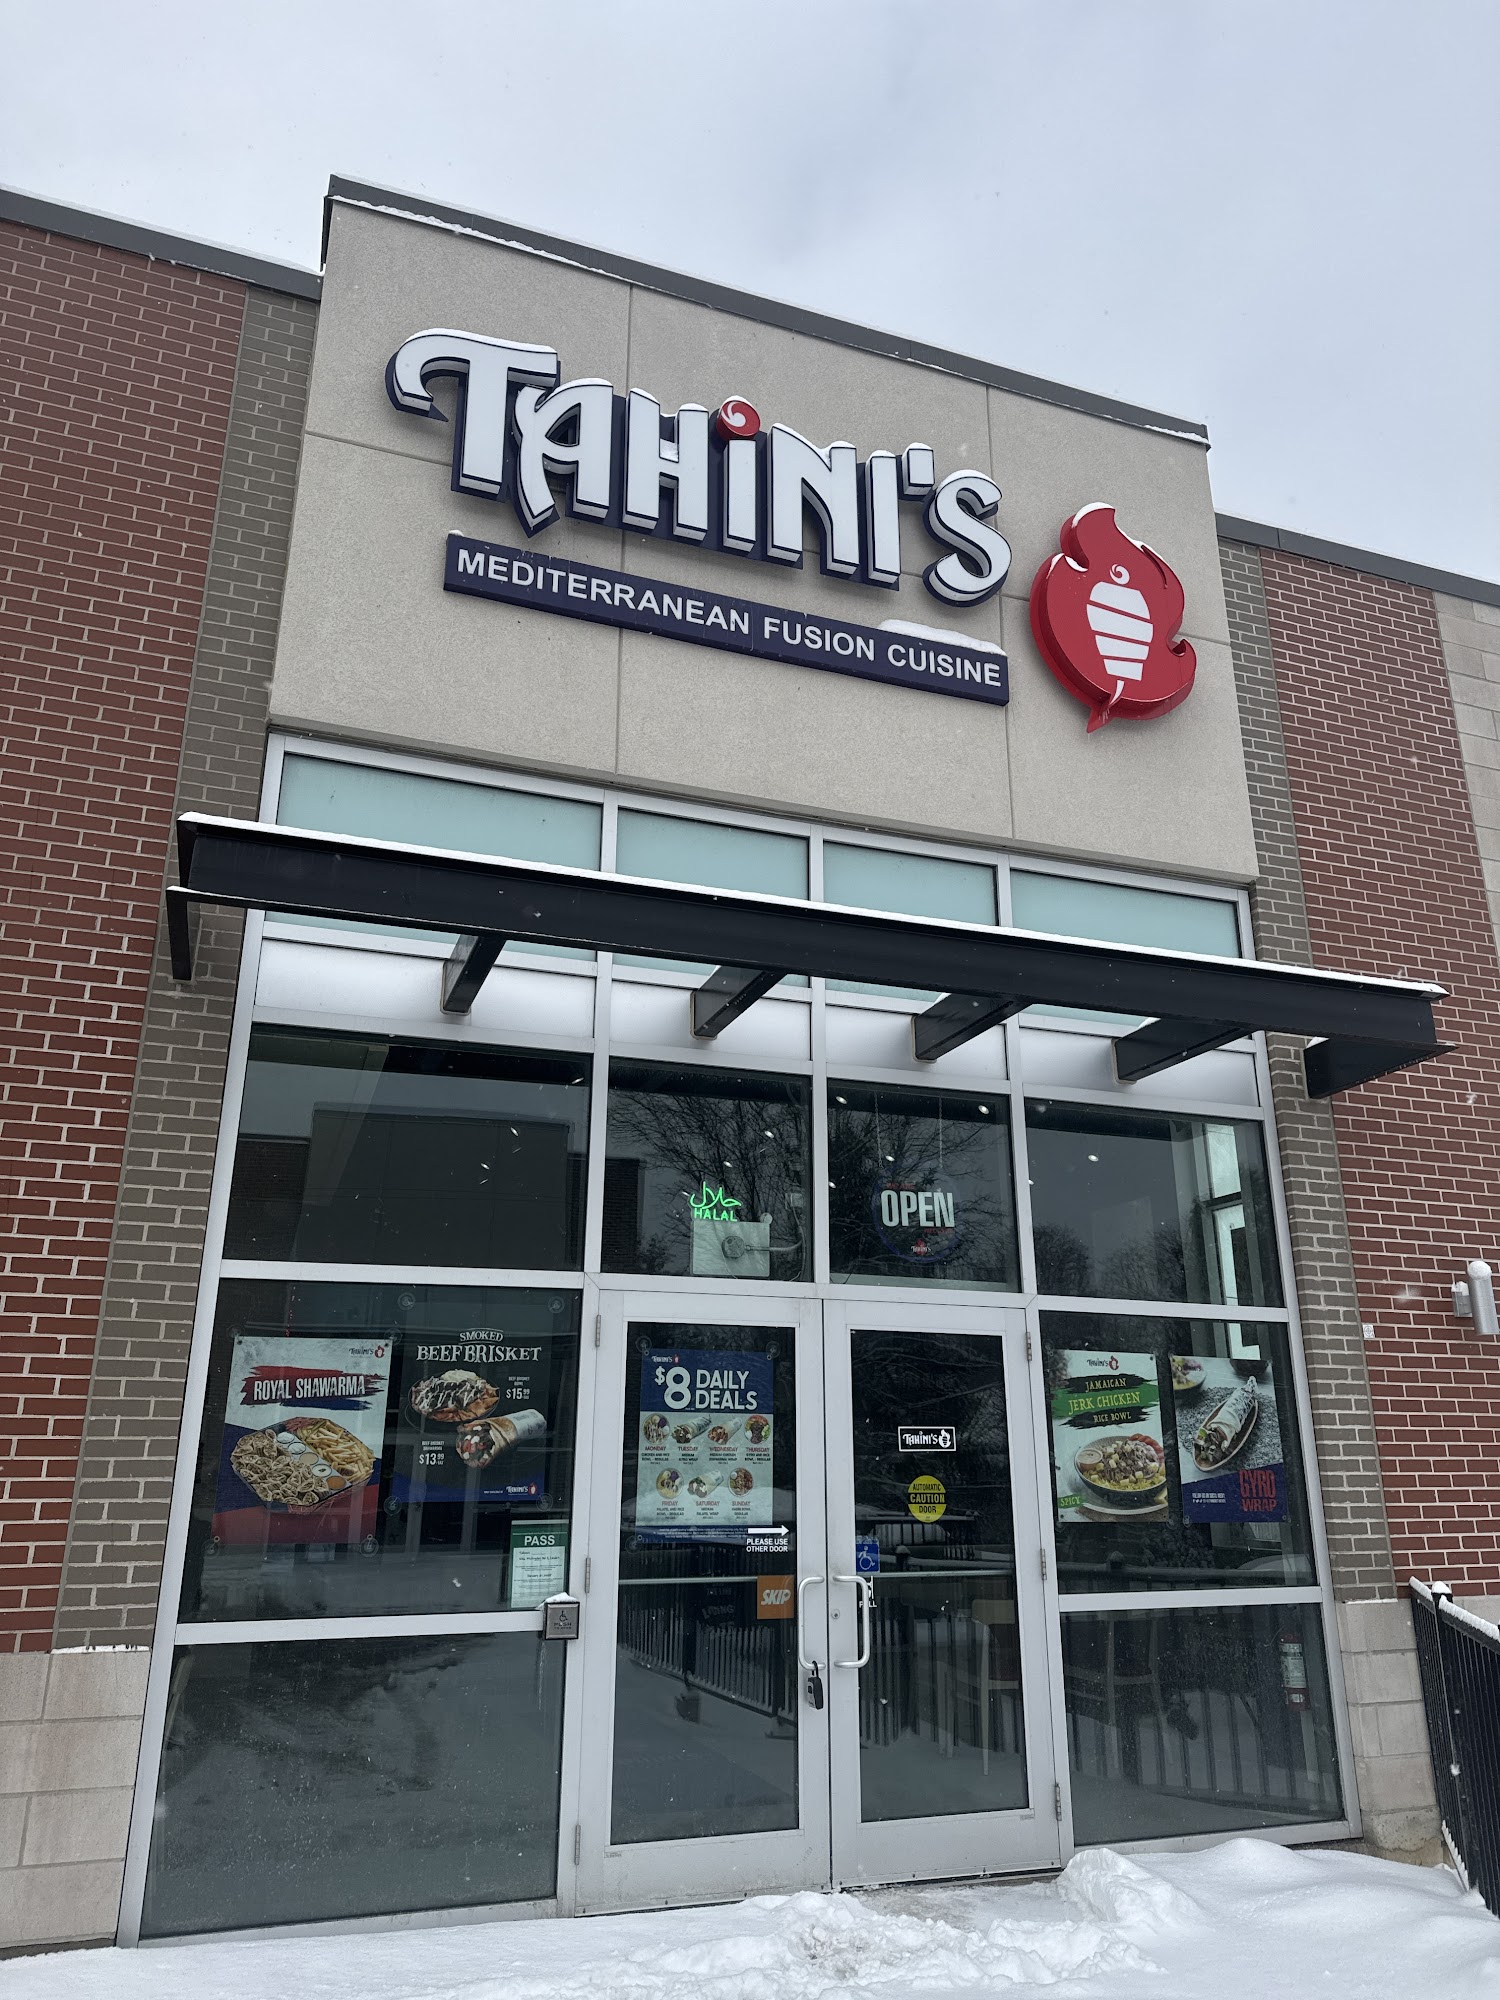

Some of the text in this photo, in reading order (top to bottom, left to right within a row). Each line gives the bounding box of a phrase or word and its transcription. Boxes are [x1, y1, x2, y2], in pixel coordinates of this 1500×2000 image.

[457, 549, 1002, 688] MEDITERRANEAN FUSION CUISINE
[690, 1181, 741, 1208] حلال
[694, 1208, 737, 1222] HALAL
[881, 1189, 955, 1228] OPEN
[459, 1330, 504, 1343] SMOKED
[416, 1344, 542, 1363] BEEF BRISKET
[253, 1376, 366, 1401] ROYAL SHAWARMA
[654, 1366, 750, 1410] $8 DAILY
[1085, 1378, 1127, 1393] JAMAICAN
[694, 1391, 758, 1411] DEALS
[1068, 1391, 1141, 1415] JERK CHICKEN
[1093, 1411, 1132, 1423] RICE BOWL
[912, 1484, 941, 1492] AUTOMATIC
[1239, 1469, 1276, 1498] GYRO
[910, 1493, 945, 1504] CAUTION
[1060, 1496, 1081, 1507] SPICY
[1242, 1498, 1277, 1512] WRAP
[918, 1505, 937, 1514] DOOR
[524, 1535, 555, 1546] PASS
[761, 1589, 791, 1605] SKIP
[859, 1600, 877, 1608] PLL
